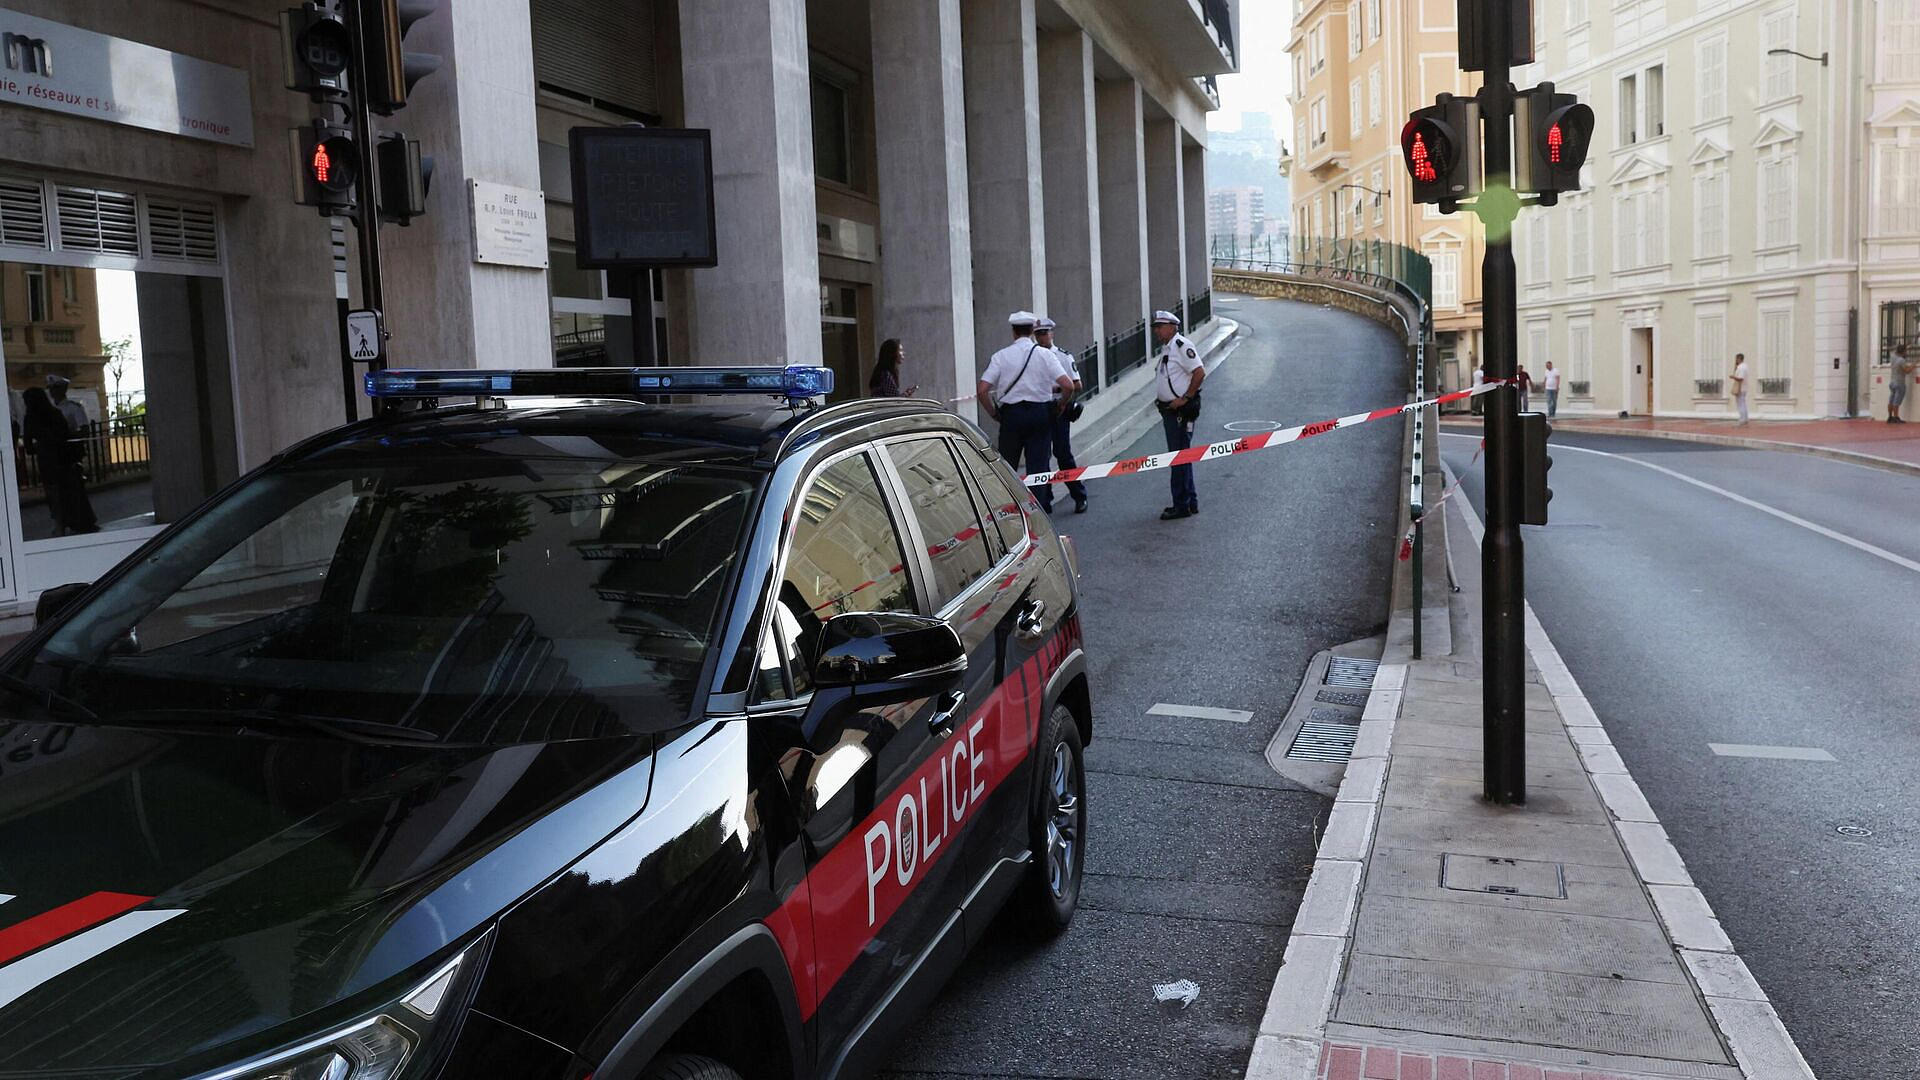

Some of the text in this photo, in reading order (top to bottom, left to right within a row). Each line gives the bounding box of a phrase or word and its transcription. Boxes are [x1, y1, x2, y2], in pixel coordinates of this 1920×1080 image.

[27, 84, 81, 105] réseaux
[86, 97, 99, 109] et
[181, 116, 231, 136] tronique
[504, 194, 518, 204] RUE
[1034, 471, 1070, 484] POLICE
[1121, 457, 1158, 472] POLICE
[1210, 440, 1249, 456] POLICE
[1301, 421, 1340, 438] POLICE
[863, 717, 986, 928] POLICE
